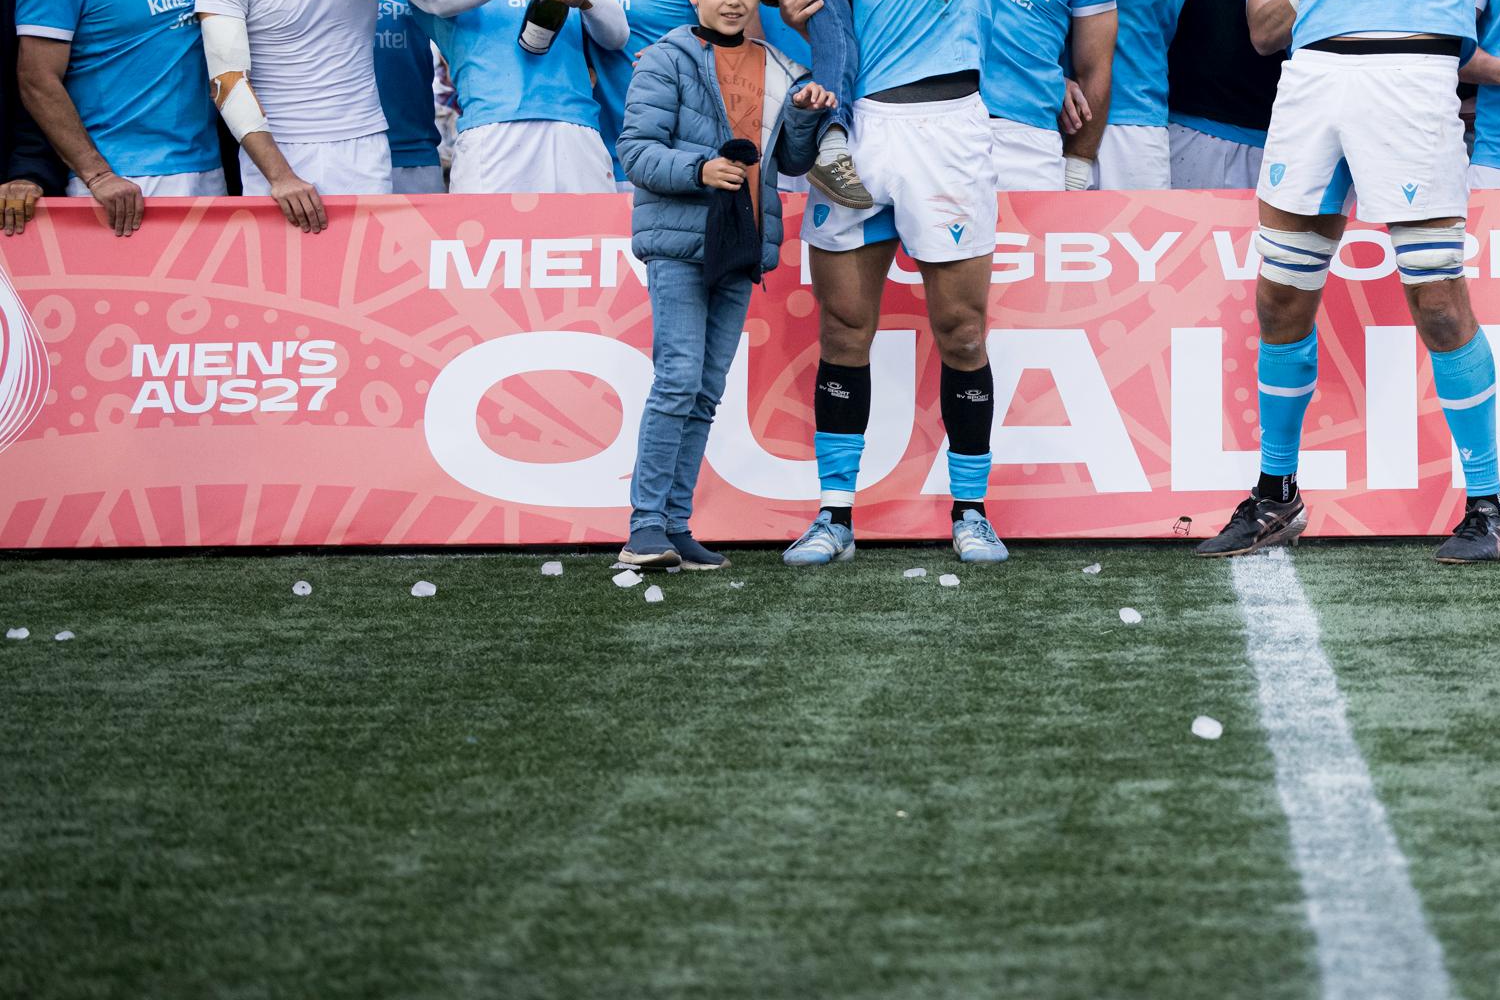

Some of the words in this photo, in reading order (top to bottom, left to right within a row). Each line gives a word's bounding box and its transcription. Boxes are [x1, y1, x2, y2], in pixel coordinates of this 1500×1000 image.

[374, 30, 408, 49] ntel
[428, 238, 650, 290] MEN
[131, 339, 338, 377] MEN'S
[129, 377, 337, 414] AUS27
